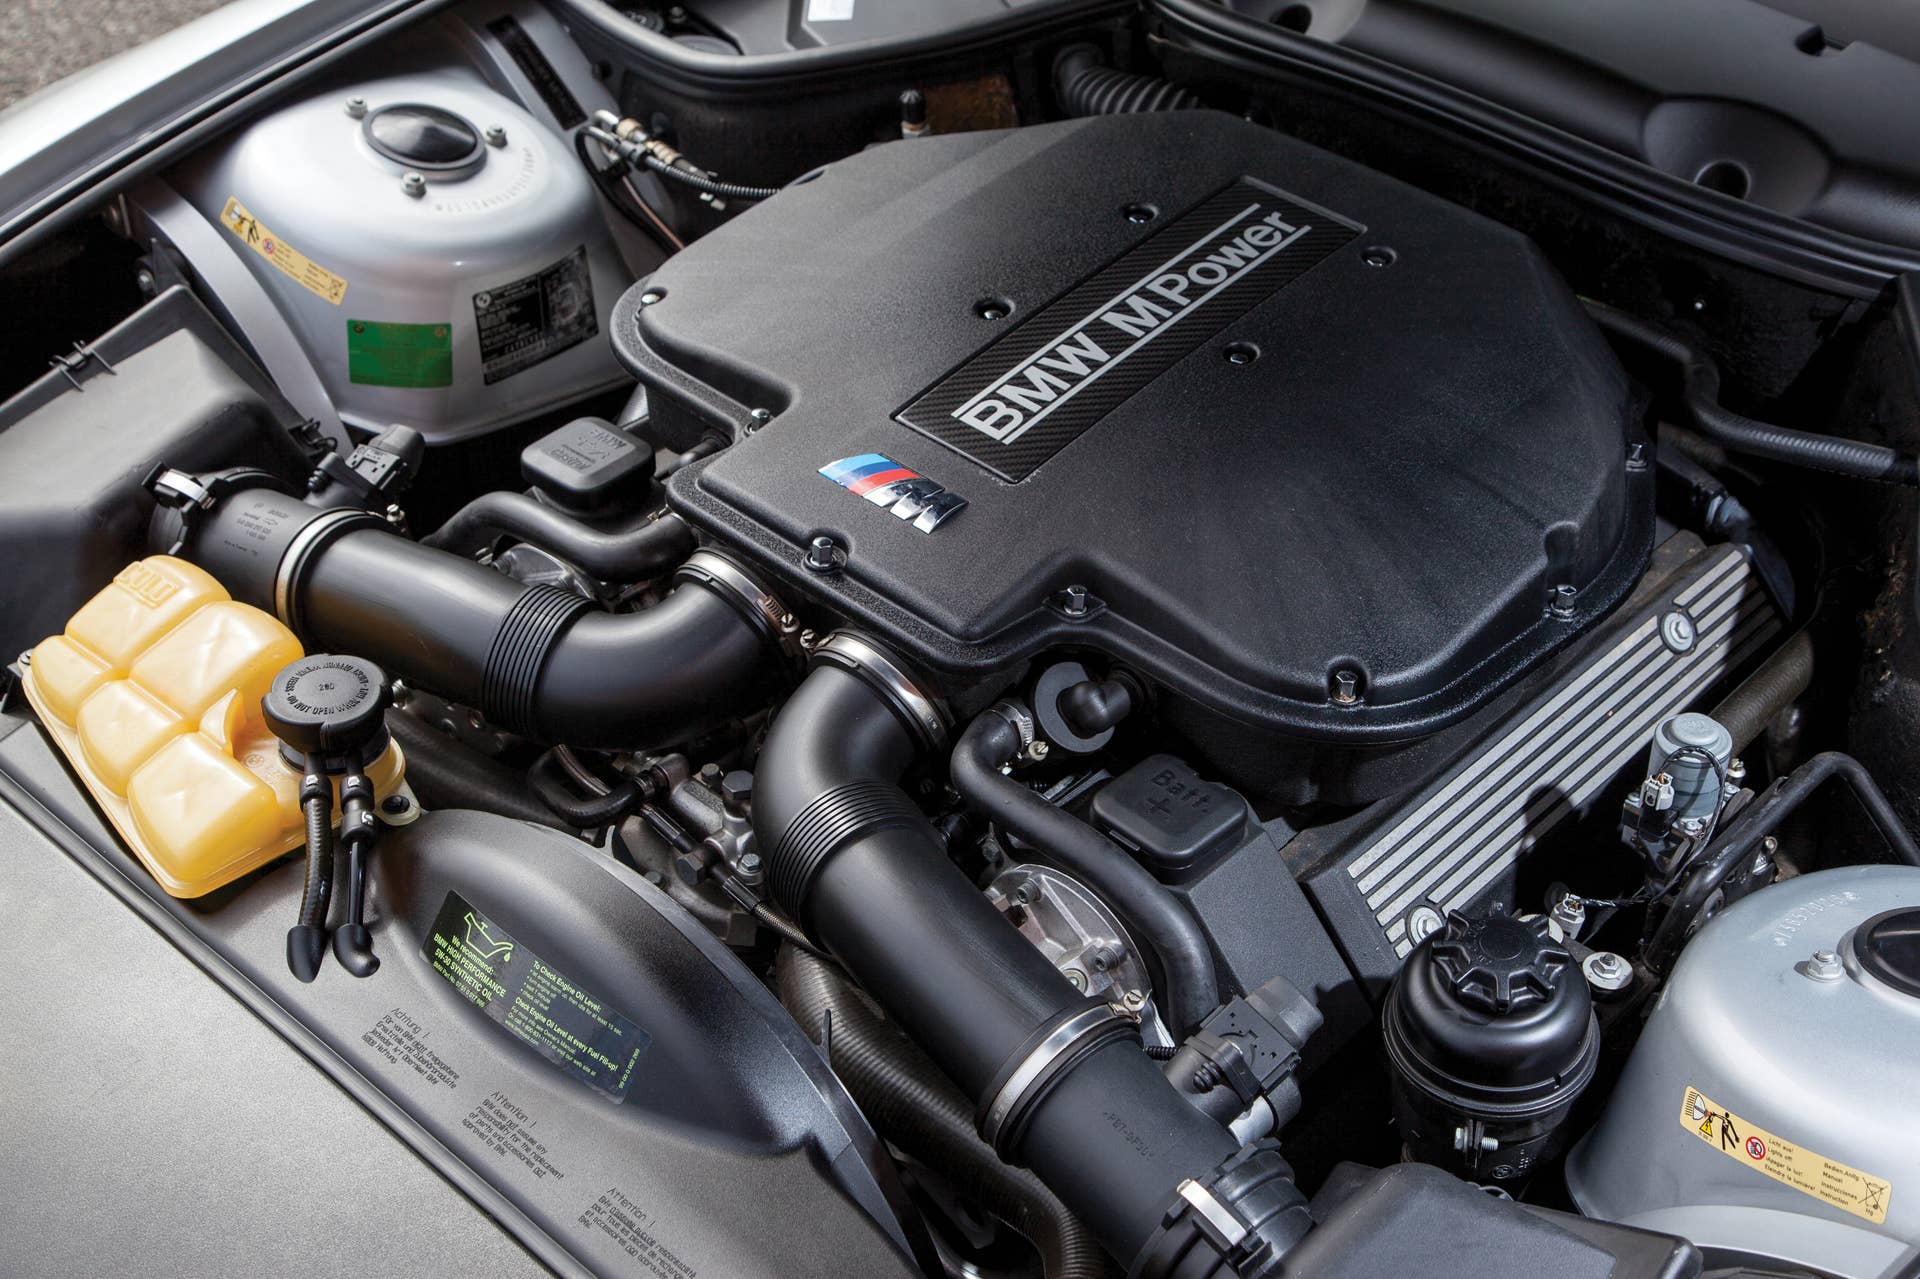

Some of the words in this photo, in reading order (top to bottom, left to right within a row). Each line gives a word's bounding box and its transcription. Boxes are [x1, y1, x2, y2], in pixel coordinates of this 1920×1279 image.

[959, 331, 1112, 441] BMW
[312, 706, 334, 715] OPEN
[434, 933, 448, 949] BMW
[446, 945, 462, 961] HIGH
[460, 957, 506, 997] PERFORMANCE
[452, 935, 461, 947] We
[460, 945, 494, 975] recommend:
[435, 948, 451, 966] 5W-30
[450, 962, 482, 992] SYNTHETIC
[481, 988, 492, 1001] OIL
[533, 960, 540, 970] To
[540, 966, 557, 982] Check
[556, 978, 575, 995] Engine
[575, 991, 585, 1001] Oil
[584, 997, 601, 1013] Level:
[391, 1008, 422, 1035] Achtung
[515, 997, 530, 1011] Check
[529, 1007, 546, 1023] Engine
[546, 1019, 555, 1028] Oil
[553, 1024, 568, 1038] Level
[573, 1039, 588, 1053] every
[587, 1047, 600, 1059] Fuel
[599, 1055, 618, 1071] Fill-up!
[490, 1091, 528, 1123] Attention
[462, 1118, 488, 1141] approved
[486, 1137, 495, 1147] by
[476, 1106, 511, 1135] responsibility
[510, 1133, 521, 1143] for
[521, 1142, 531, 1153] the
[482, 1099, 496, 1110] BMW
[493, 1109, 507, 1121] does
[506, 1119, 519, 1131] not
[517, 1129, 537, 1146] assume
[536, 1144, 548, 1155] any
[475, 1118, 493, 1133] parts
[492, 1132, 505, 1142] and
[503, 1140, 535, 1169] accessories
[532, 1167, 546, 1178] not
[1767, 1146, 1783, 1158] Lights
[1821, 1181, 1858, 1201] Instrucciones
[1822, 1171, 1843, 1184] Manual
[607, 1187, 647, 1221] Attention
[1820, 1190, 1849, 1206] Instruction
